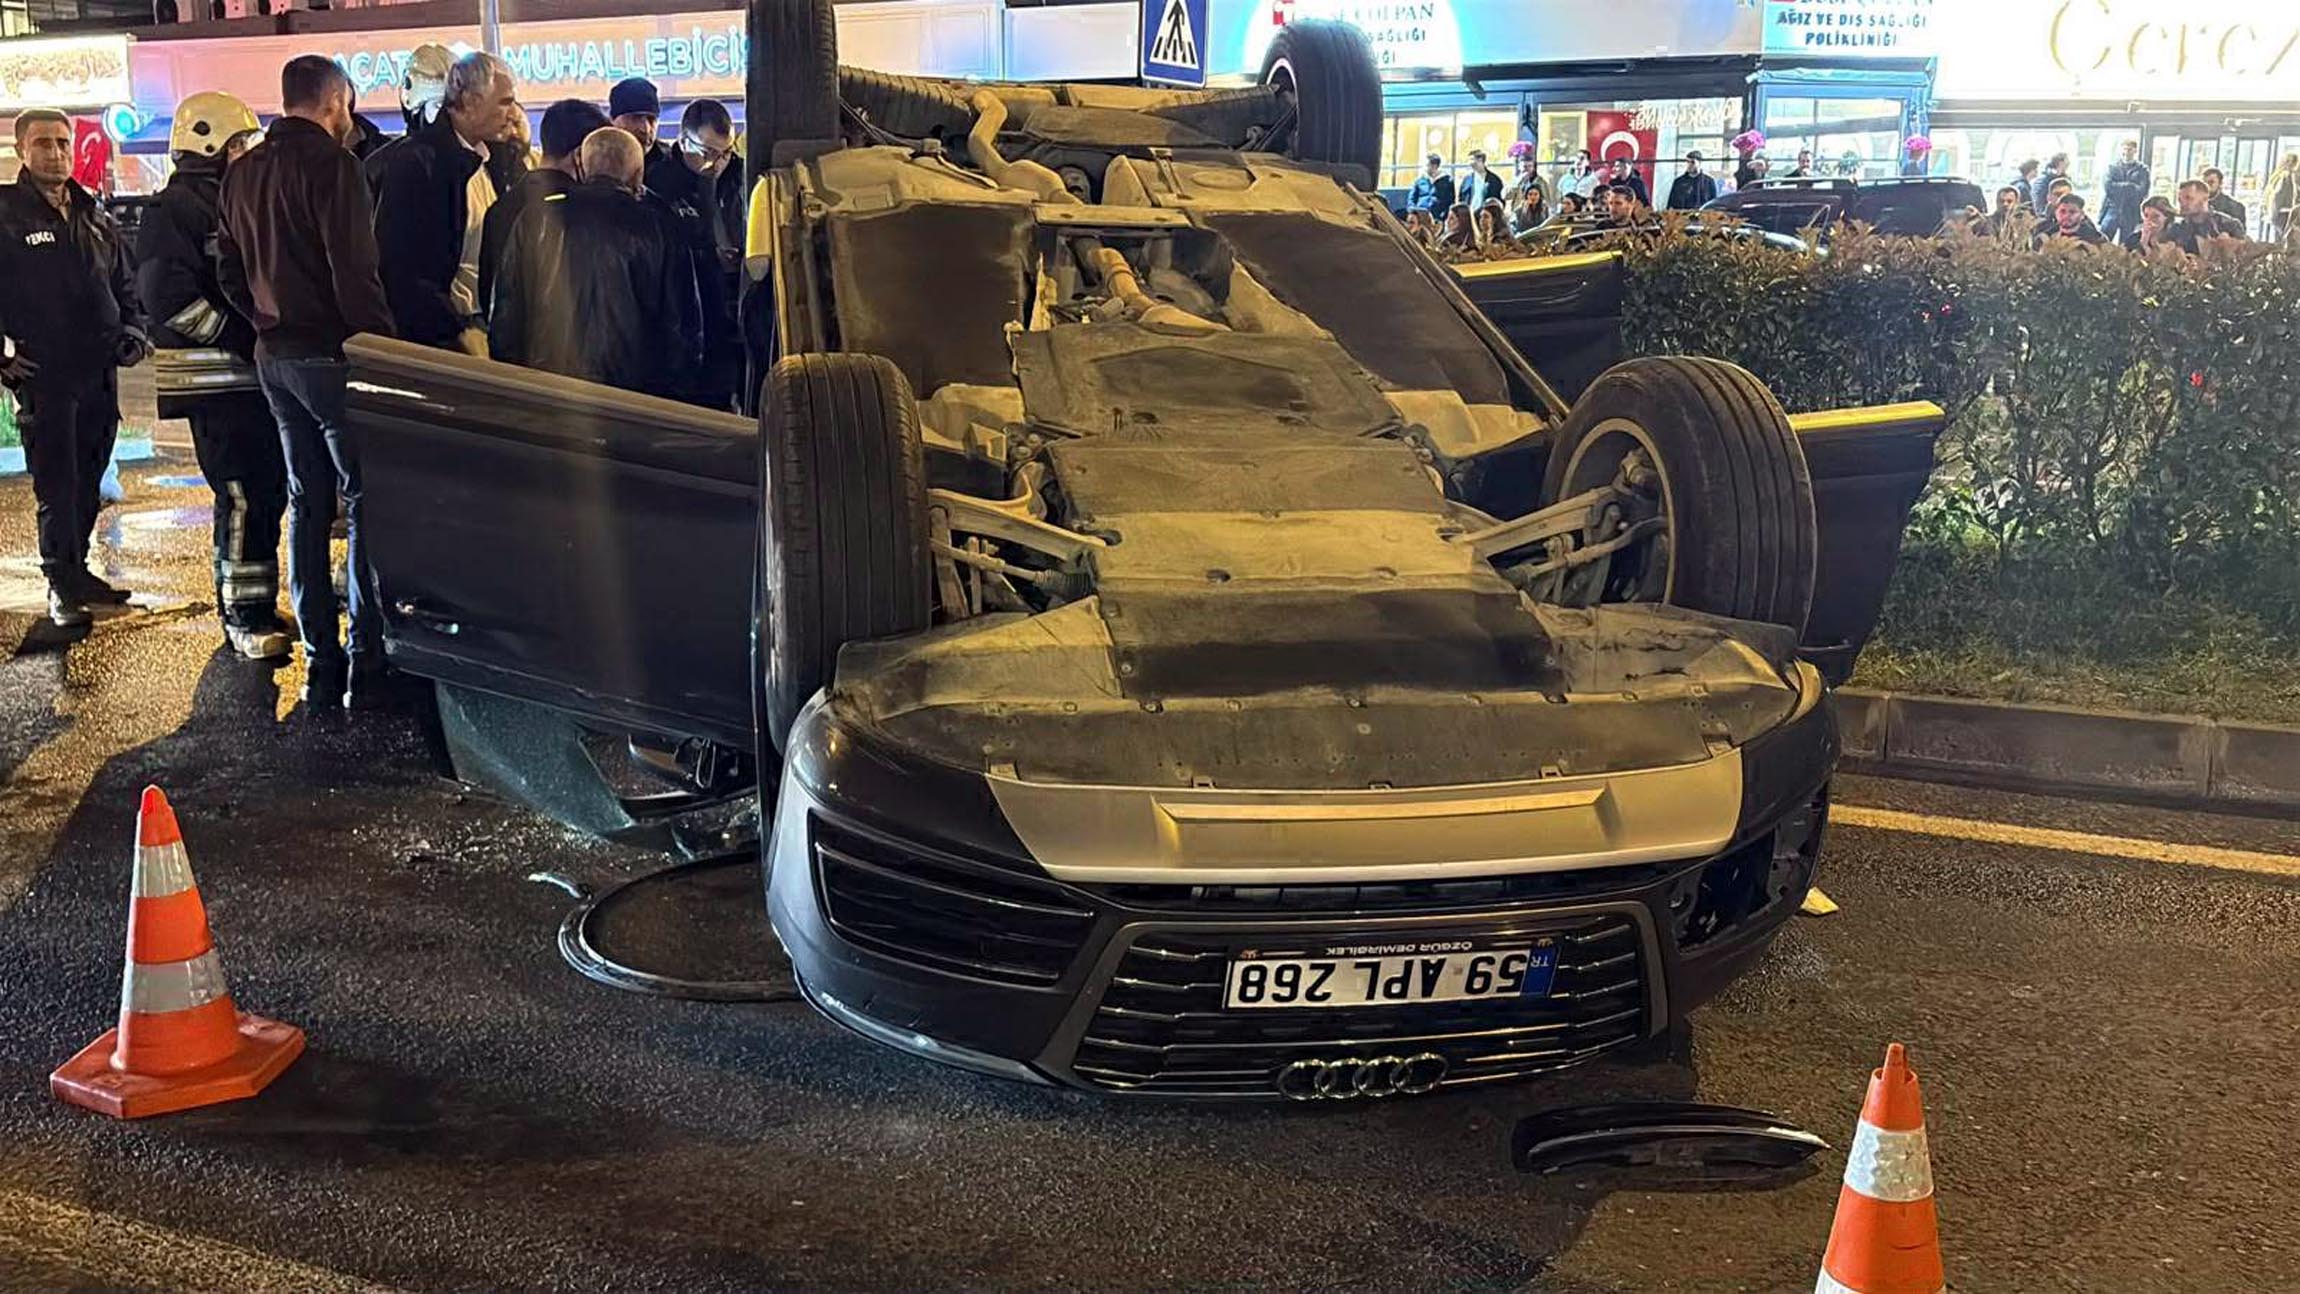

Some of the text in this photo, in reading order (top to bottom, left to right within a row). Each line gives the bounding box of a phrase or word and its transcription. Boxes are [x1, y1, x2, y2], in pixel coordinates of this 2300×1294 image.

[1777, 9, 1811, 25] AĞIZ
[1816, 12, 1833, 26] VE
[1238, 954, 1549, 1003] TR 59 APL 268
